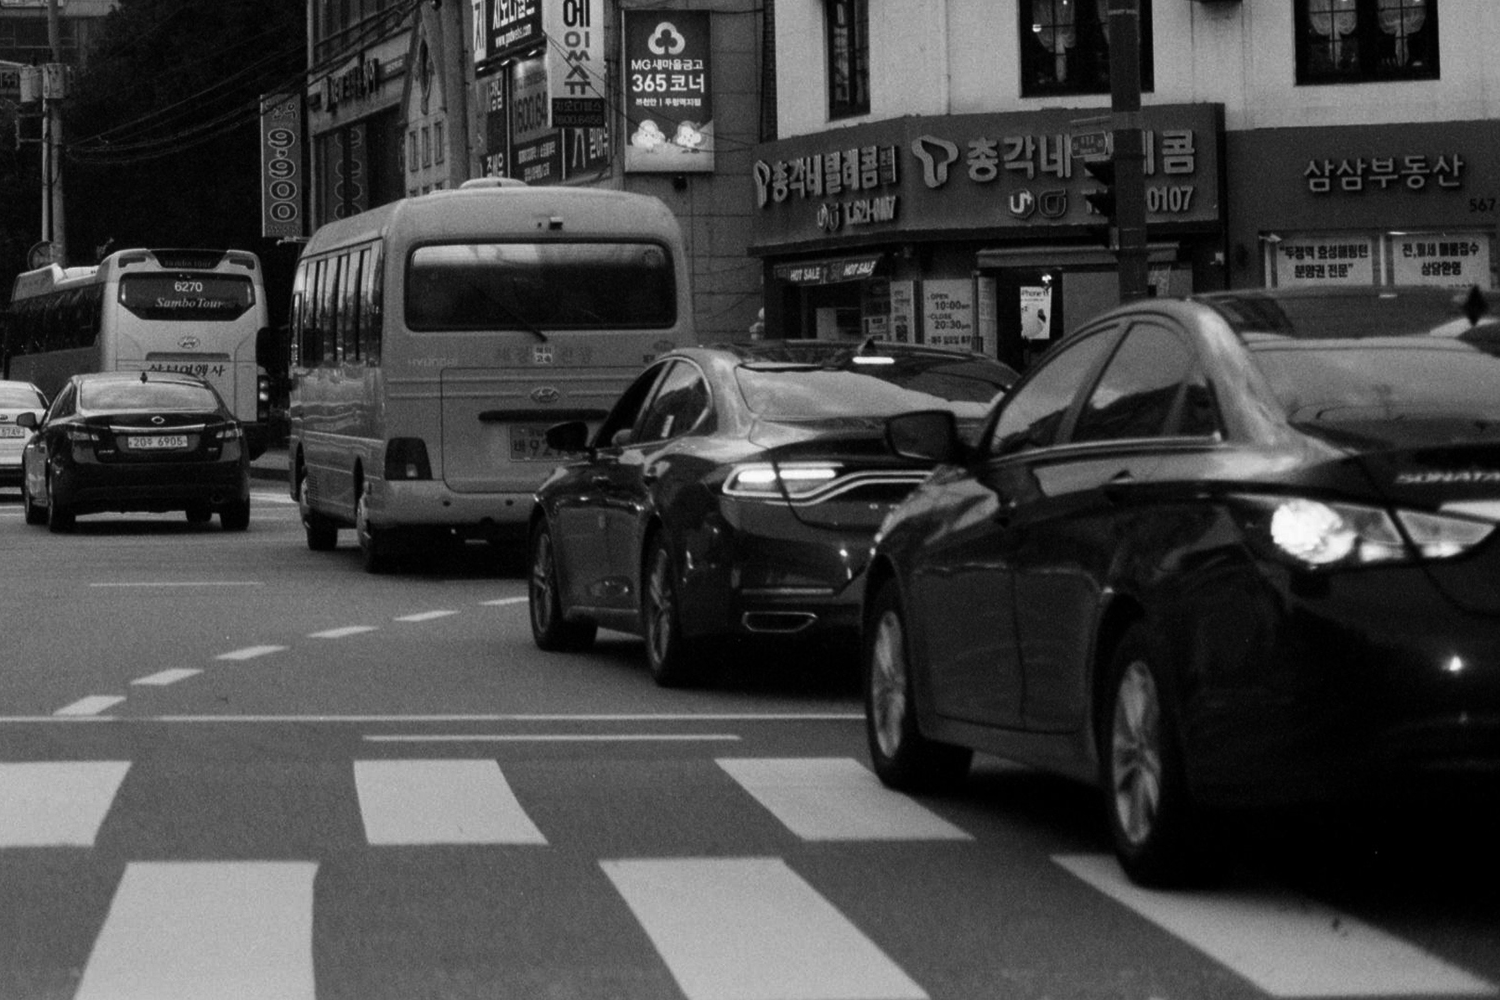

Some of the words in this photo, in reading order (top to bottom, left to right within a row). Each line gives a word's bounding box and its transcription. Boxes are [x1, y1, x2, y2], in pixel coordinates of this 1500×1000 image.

[631, 59, 651, 71] MG
[652, 59, 704, 71] 새마을금고
[632, 74, 667, 93] 365
[670, 73, 705, 94] 코너
[1303, 154, 1464, 193] 삼삼부동산
[1469, 198, 1496, 213] 567
[174, 281, 203, 293] 6270
[155, 297, 196, 310] Sambo
